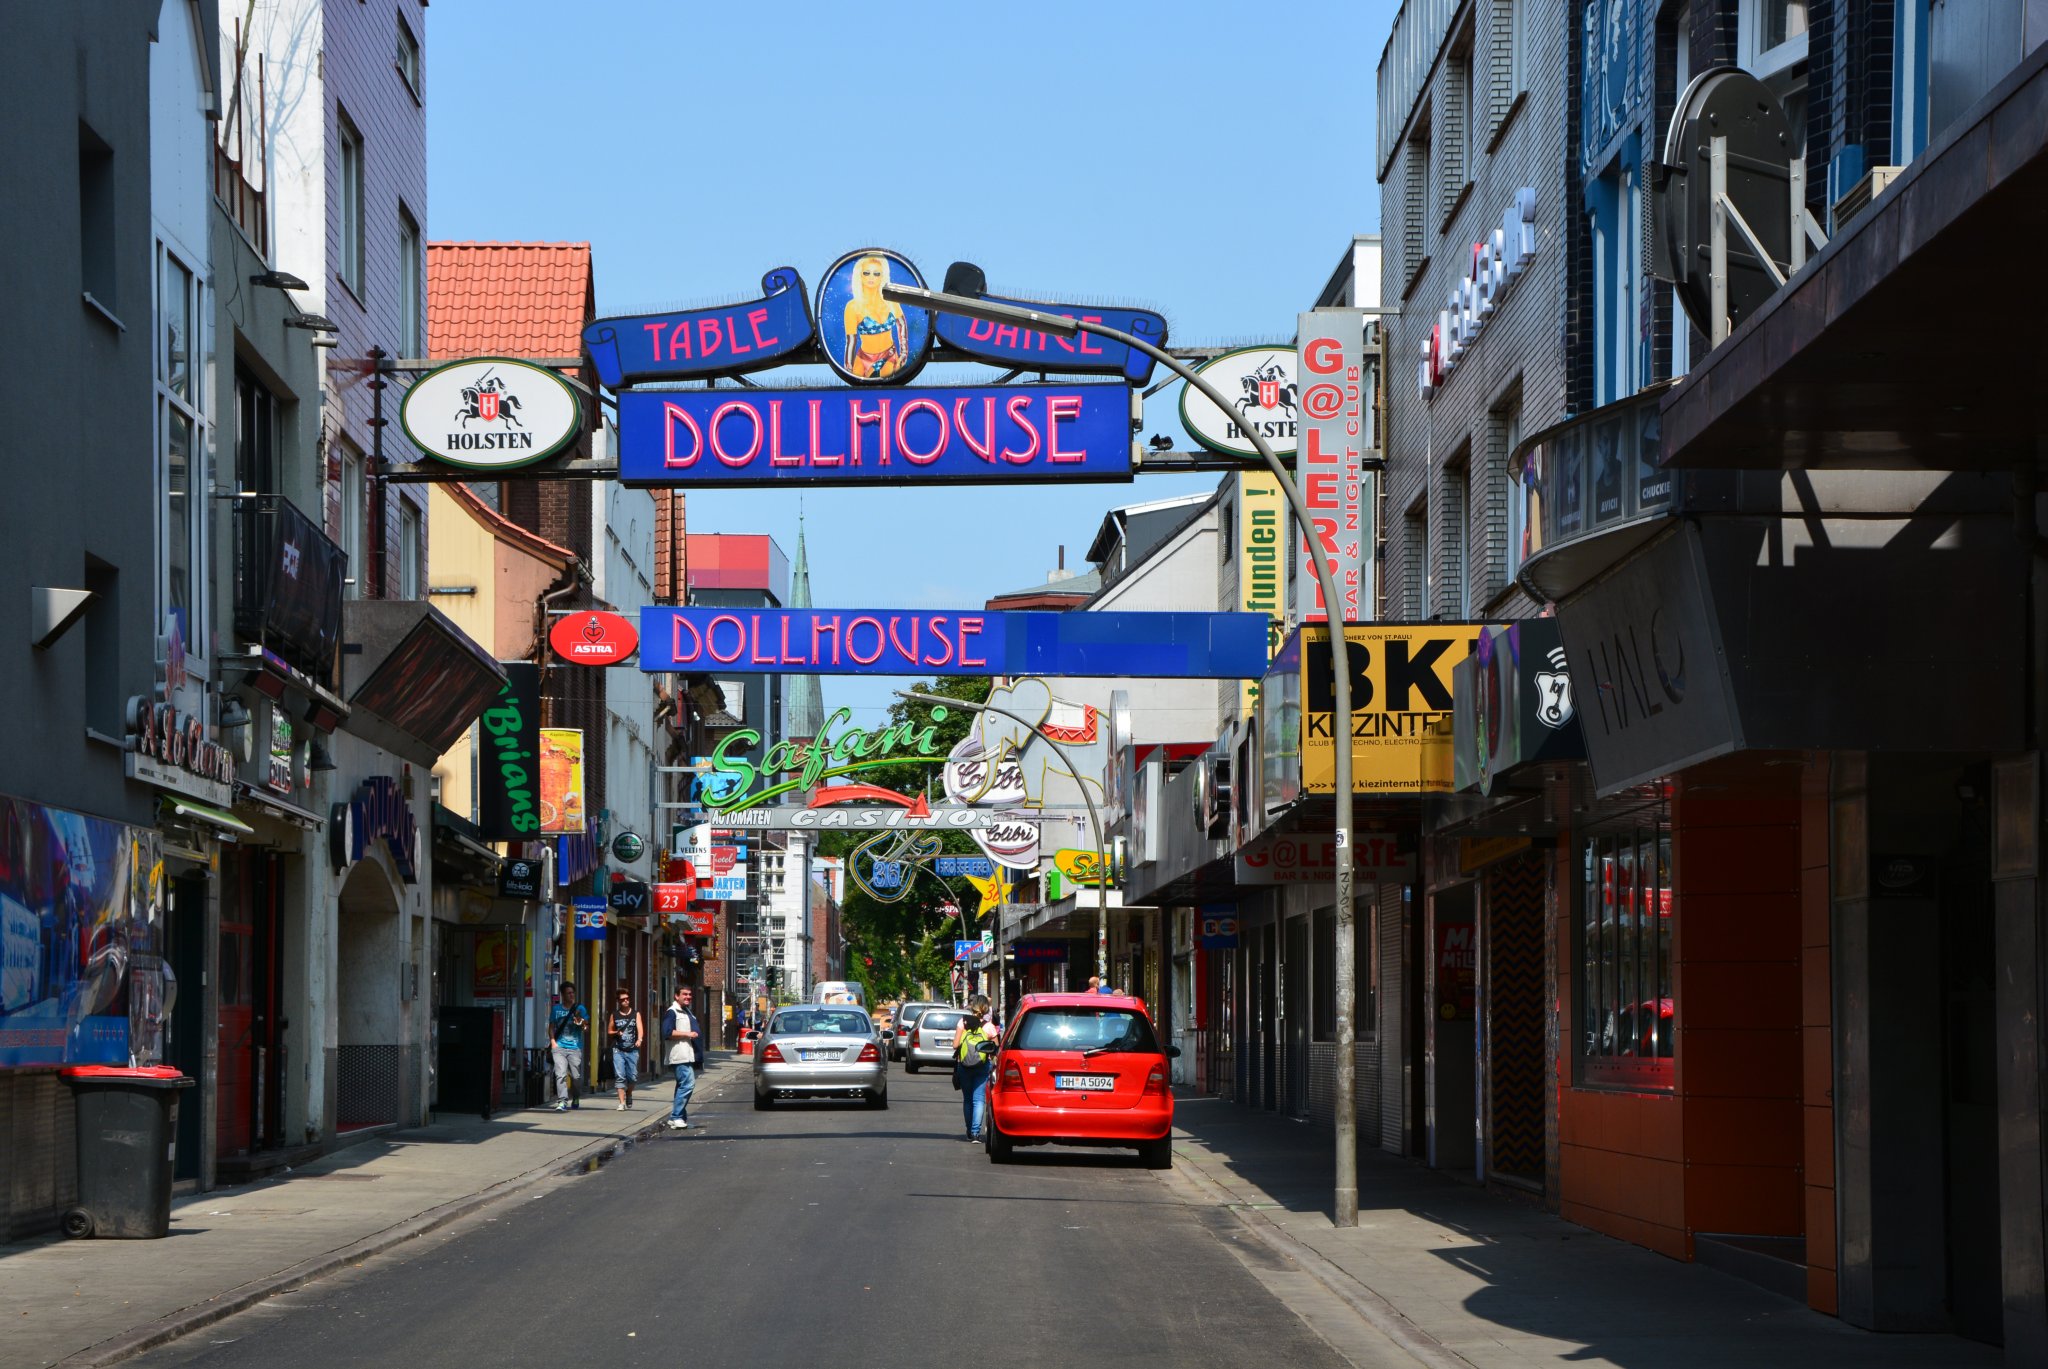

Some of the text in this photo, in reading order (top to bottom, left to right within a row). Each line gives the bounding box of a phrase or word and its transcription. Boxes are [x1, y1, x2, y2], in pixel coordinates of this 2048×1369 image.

[643, 308, 779, 362] TABLE
[1345, 365, 1360, 437] CLUB
[447, 431, 533, 451] HOLSTEN
[663, 396, 1087, 468] DOLLHOUSE
[1345, 446, 1360, 531] NIGHT
[1642, 481, 1671, 499] CHUCKIE
[575, 644, 613, 655] ASTRA
[672, 614, 986, 666] DOLLHOUSE
[702, 705, 949, 809] Safari
[712, 808, 978, 827] AUTOMATEN CASINO
[985, 823, 1034, 842] Colibri
[872, 861, 900, 888] 36
[1274, 871, 1297, 880] BAR
[612, 889, 644, 908] sky
[661, 895, 679, 909] 23
[716, 891, 733, 899] HOF
[1061, 1077, 1112, 1088] HH A 5094
